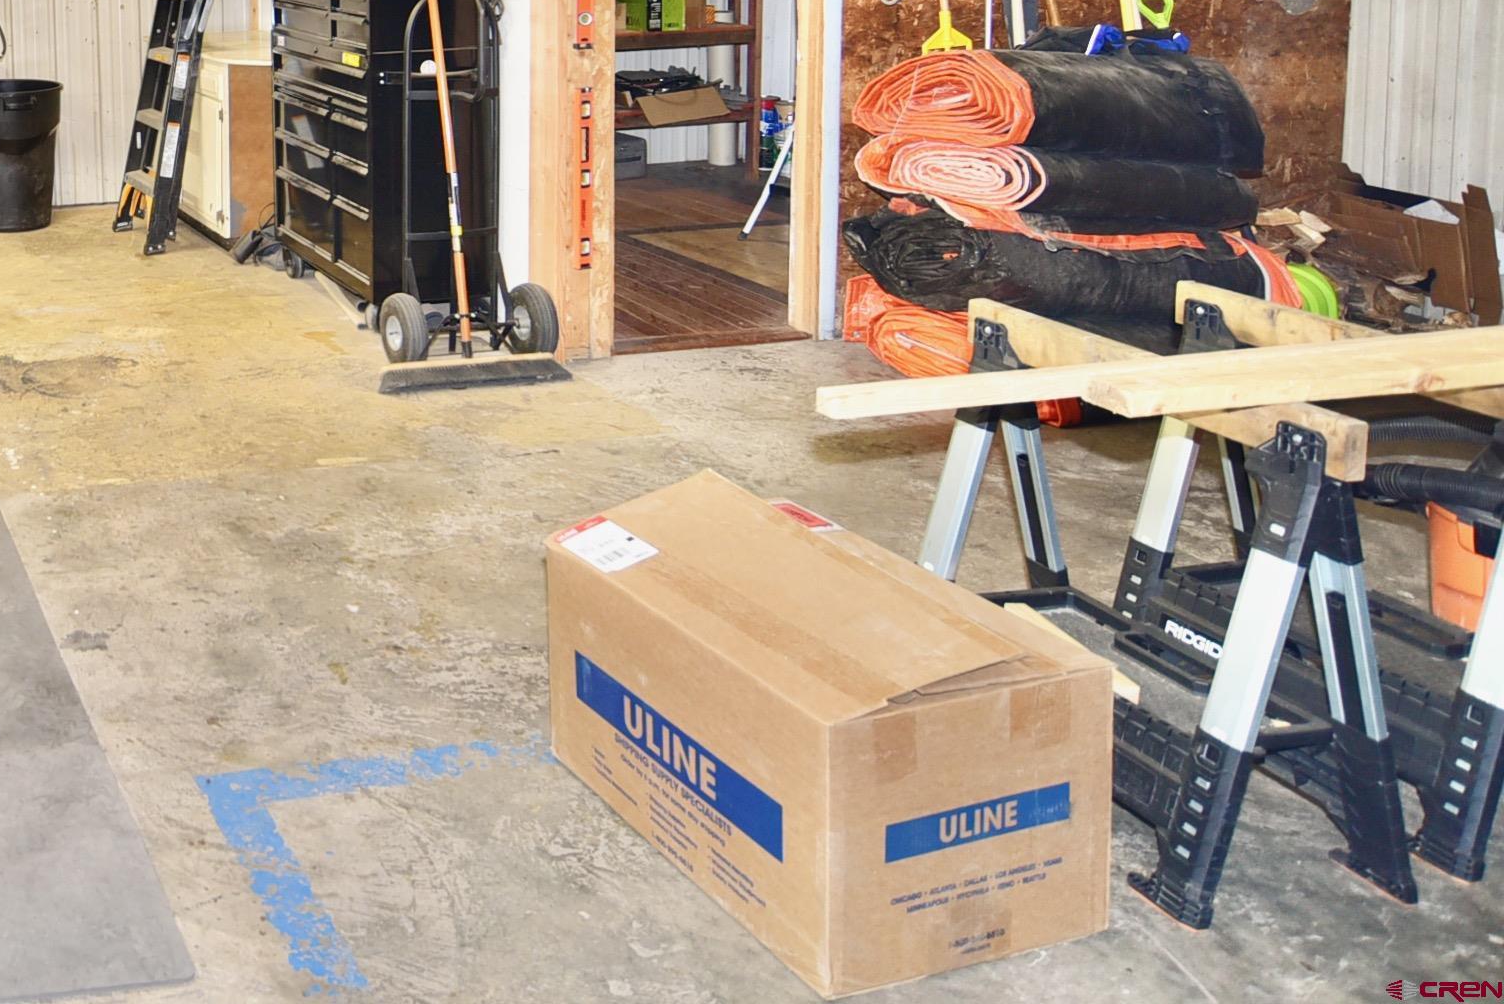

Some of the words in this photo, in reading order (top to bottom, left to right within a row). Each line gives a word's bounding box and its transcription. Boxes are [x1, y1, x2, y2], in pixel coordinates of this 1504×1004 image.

[1165, 619, 1223, 659] RIDGID
[622, 695, 717, 801] ULINE
[939, 800, 1018, 843] ULINE
